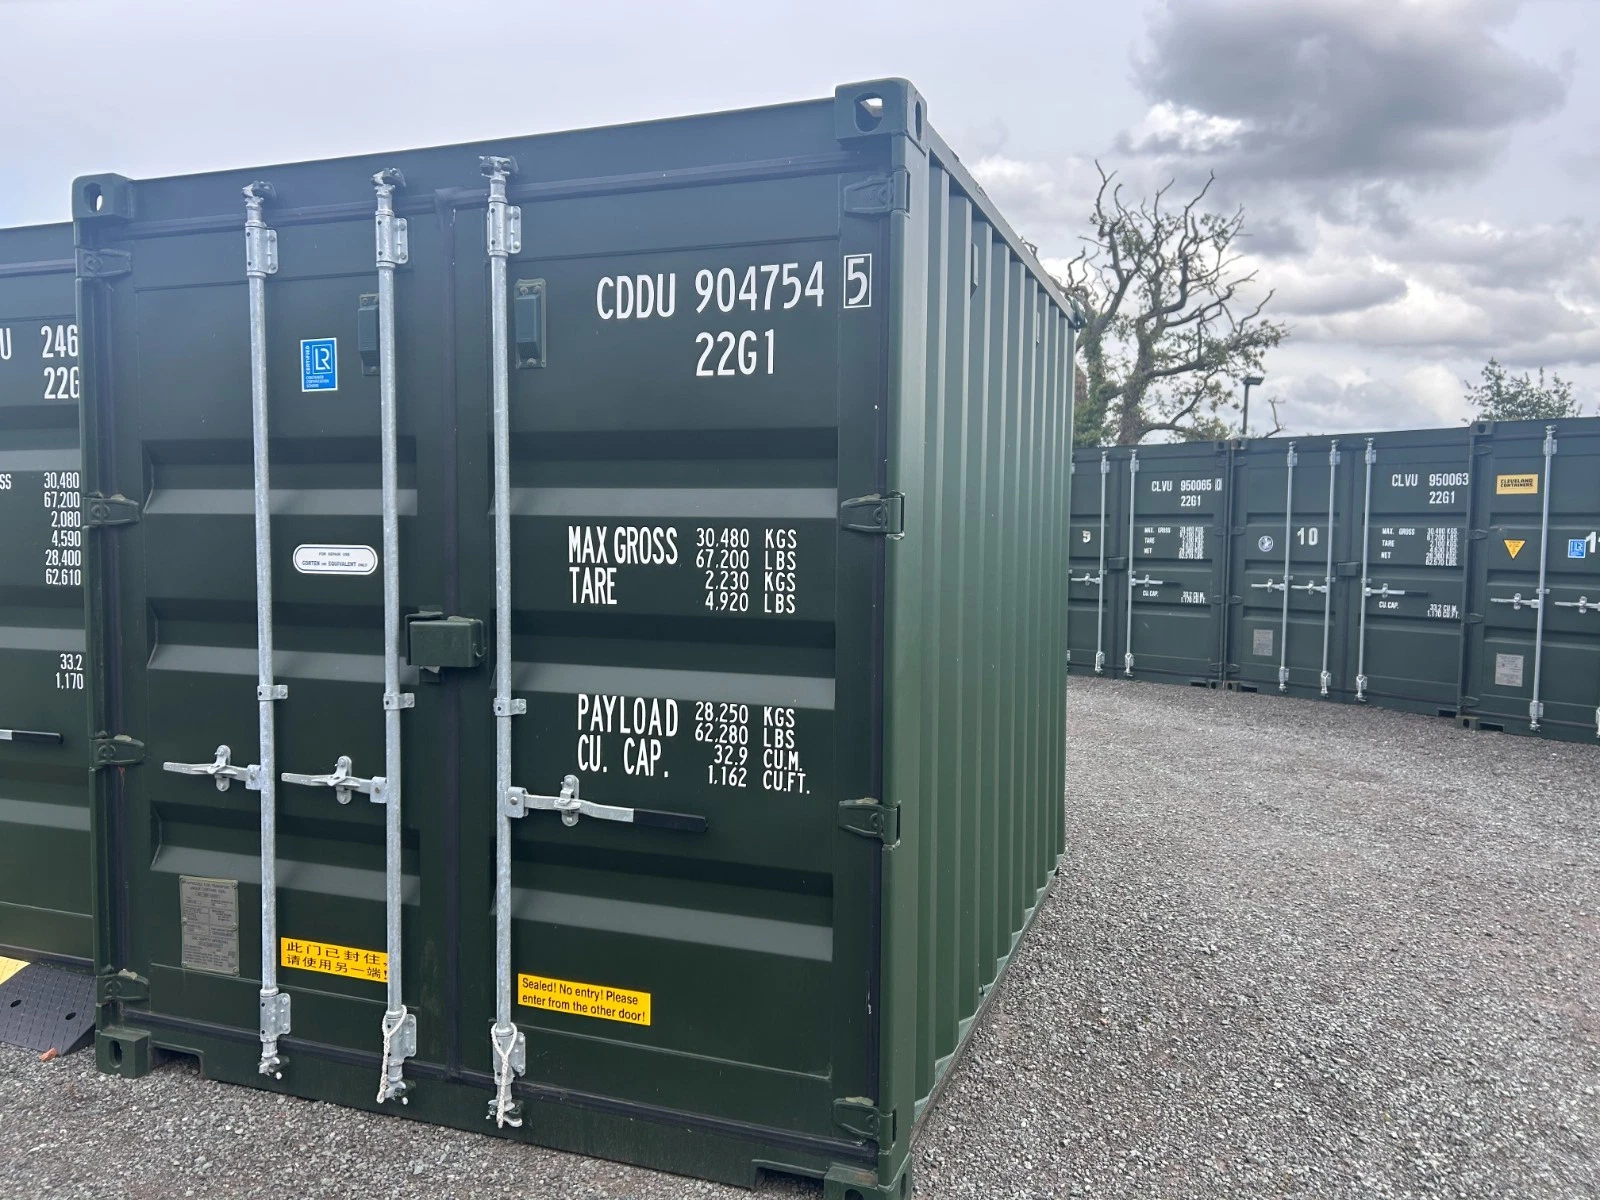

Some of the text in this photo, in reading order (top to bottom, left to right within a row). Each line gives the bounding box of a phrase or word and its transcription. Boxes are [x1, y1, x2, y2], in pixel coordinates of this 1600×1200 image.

[597, 256, 869, 320] CDDU 904754 5
[41, 324, 79, 358] 246
[695, 329, 775, 377] 22G1
[44, 366, 79, 399] 22G
[44, 472, 80, 489] 30,480
[1151, 480, 1173, 492] CLVU
[1180, 479, 1212, 492] 950065
[1391, 472, 1469, 487] CLVU 950063
[44, 491, 80, 508] 67,200
[1180, 495, 1201, 507] 22G1
[1429, 490, 1455, 504] 22G1
[51, 511, 81, 528] 2,080
[51, 530, 81, 547] 4,590
[1297, 527, 1318, 546] 10
[1398, 527, 1416, 536] GROSS
[568, 526, 797, 565] MAX GROSS 30,480 KGS
[1382, 539, 1395, 547] TARE
[45, 549, 81, 566] 28,400
[696, 549, 796, 571] 67,200 LBS
[1381, 551, 1391, 559] NET
[46, 568, 81, 586] 62,610
[569, 566, 796, 605] TARE 2,230 KGS
[705, 591, 796, 614] 4,920 LBS
[60, 653, 83, 671] 33.2
[56, 671, 84, 690] 1,170
[577, 693, 795, 737] PAYLOAD 28,250 KGS
[695, 722, 795, 749] 62,280 LBS
[577, 733, 803, 778] CU. CAP. 32.9 CU.M.
[708, 764, 810, 795] 1,162 CU.FT.
[522, 977, 638, 1005] Sealed! No entry! Please
[522, 994, 645, 1022] enter from the other door!
